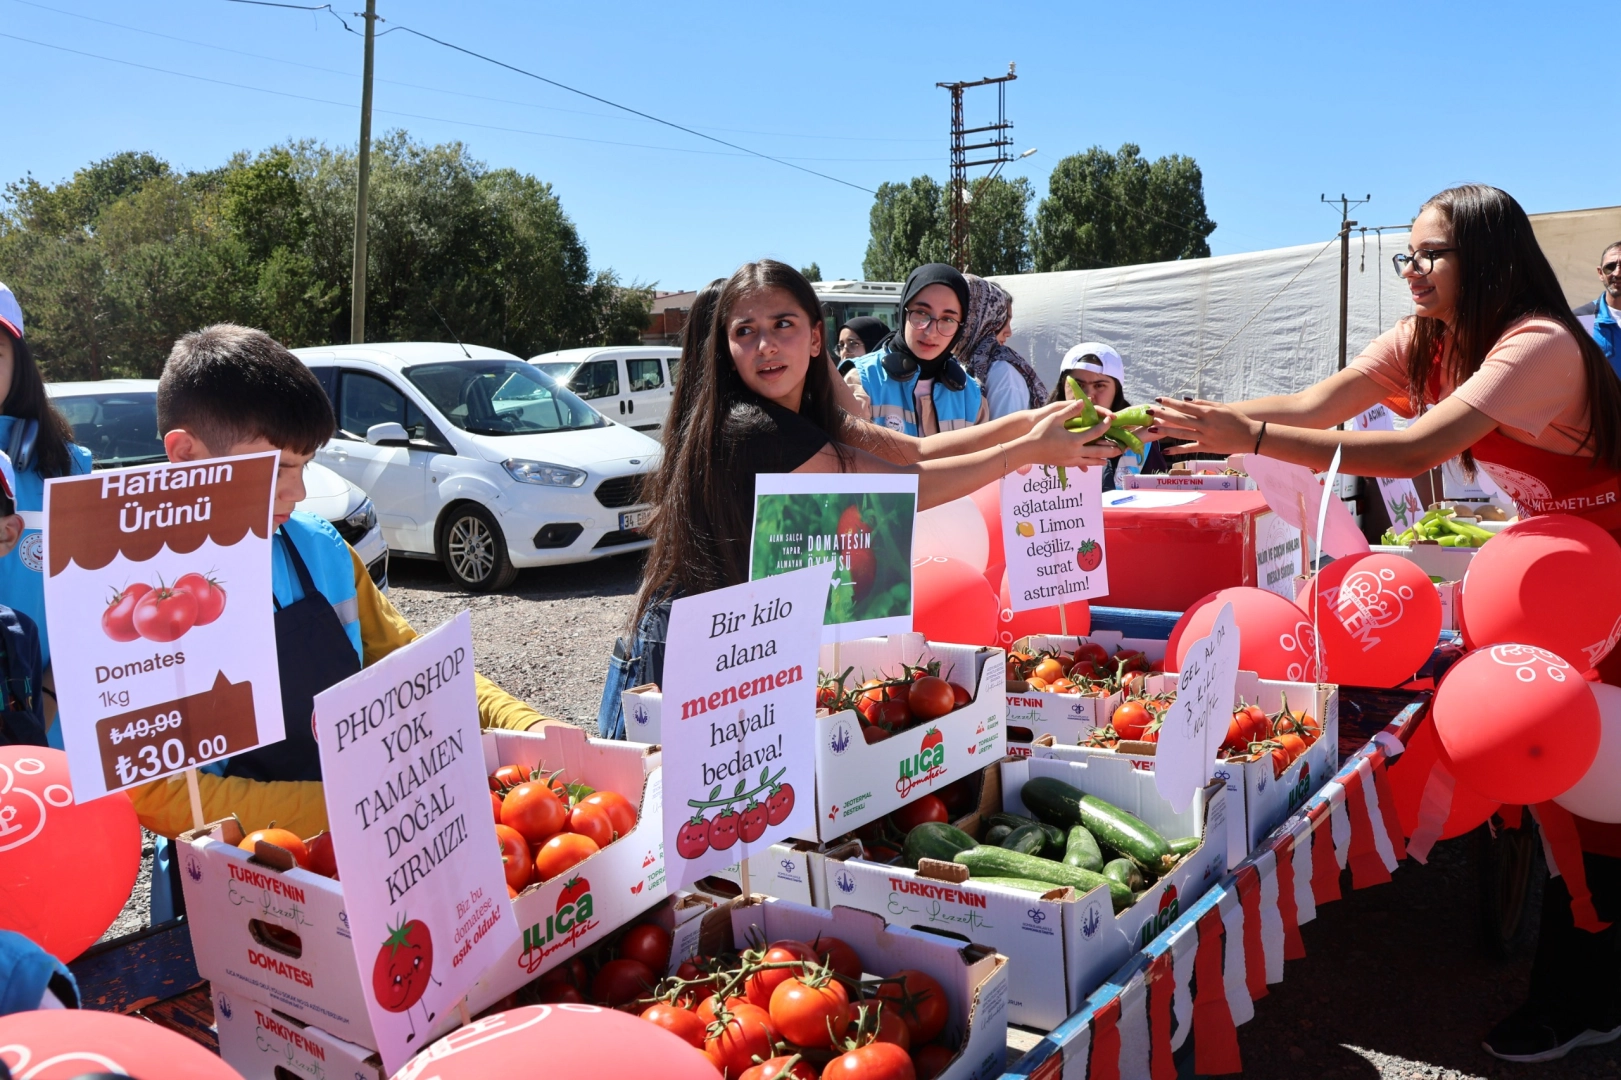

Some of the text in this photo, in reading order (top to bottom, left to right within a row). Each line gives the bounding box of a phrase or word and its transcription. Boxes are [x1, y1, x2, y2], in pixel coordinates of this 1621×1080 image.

[101, 463, 233, 498] Haftanın
[1023, 475, 1072, 494] değili,
[119, 497, 213, 533] Ürünü
[1013, 492, 1083, 518] ağlatalım!
[786, 533, 803, 542] SALÇA
[807, 529, 871, 552] DOMATESİN
[1039, 517, 1085, 534] Limon
[783, 546, 803, 555] YAPAR,
[1026, 539, 1074, 558] değiliz,
[1036, 559, 1074, 577] surat
[1024, 575, 1090, 601] astıralım!
[708, 597, 793, 639] Bir kilo
[95, 651, 186, 684] Domates
[715, 639, 777, 672] alana
[680, 665, 803, 720] menemen
[1181, 661, 1201, 691] GEL
[98, 688, 130, 708] 1kg
[335, 647, 466, 753] PHOTOSHOP
[380, 711, 434, 763] YOK,
[710, 703, 775, 748] hayali
[702, 734, 783, 787] bedava!
[355, 728, 465, 831] TAMAMEN
[896, 764, 948, 799] Domatesi
[843, 791, 872, 809] JEOTERMAL
[383, 783, 455, 860] DOĞAL
[385, 814, 469, 906] KIRMIZI!
[227, 863, 306, 904] TÜRKİYE'NİN
[228, 879, 254, 906] En
[889, 878, 987, 909] TÜRKİYE'NİN
[456, 887, 483, 919] Biz bu
[887, 892, 919, 915] En
[452, 904, 501, 968] aşık olduk!
[454, 898, 492, 944] domatese
[518, 920, 599, 974] Domatesi
[248, 949, 314, 989] DOMATESİ
[254, 1010, 326, 1062] TÜRKİYE'NİN
